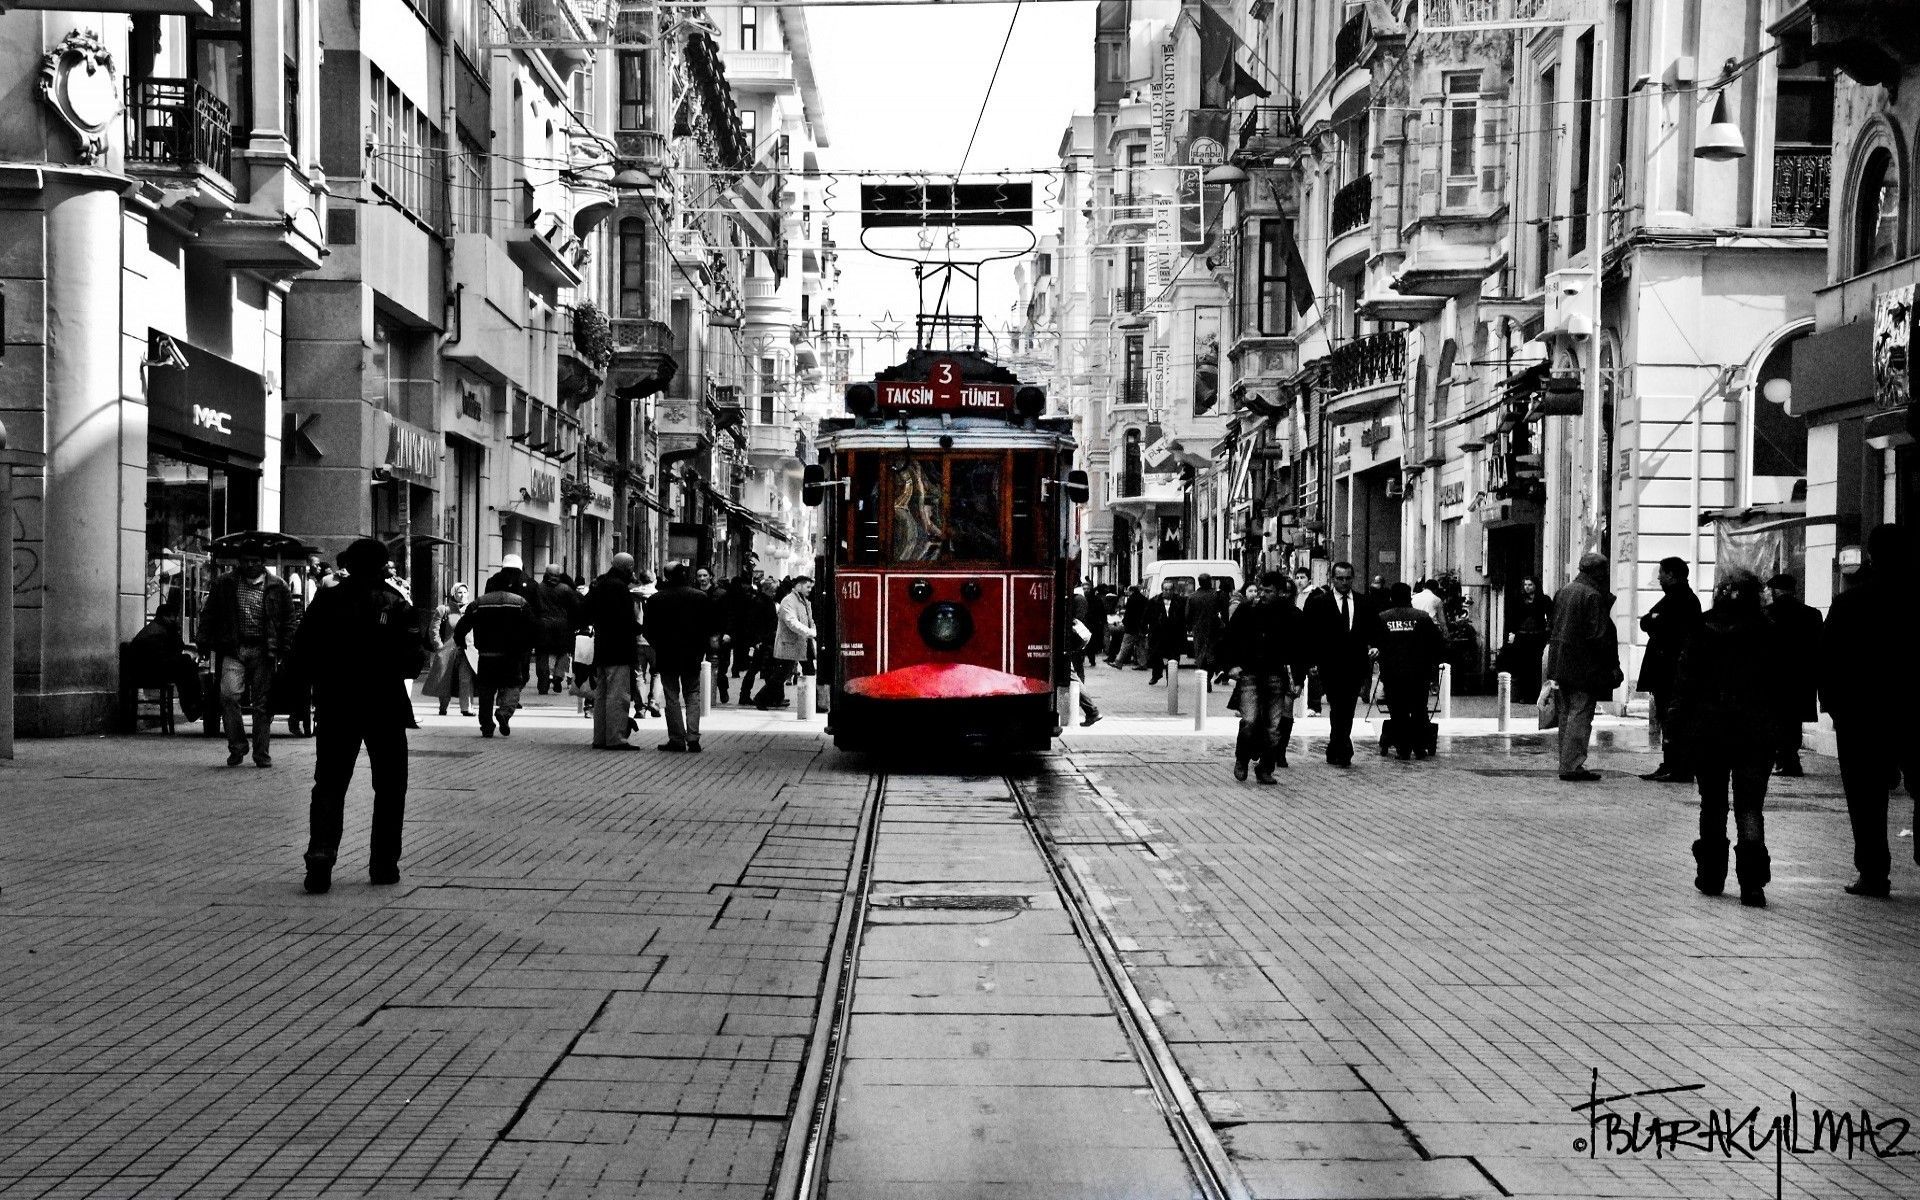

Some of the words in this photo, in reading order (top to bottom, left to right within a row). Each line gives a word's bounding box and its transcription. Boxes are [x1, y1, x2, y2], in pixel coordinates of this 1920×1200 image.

[938, 364, 953, 384] 3
[886, 386, 934, 405] TAKSİM
[960, 387, 1005, 407] TÜNEL
[841, 581, 861, 599] 410
[1029, 582, 1049, 600] 410
